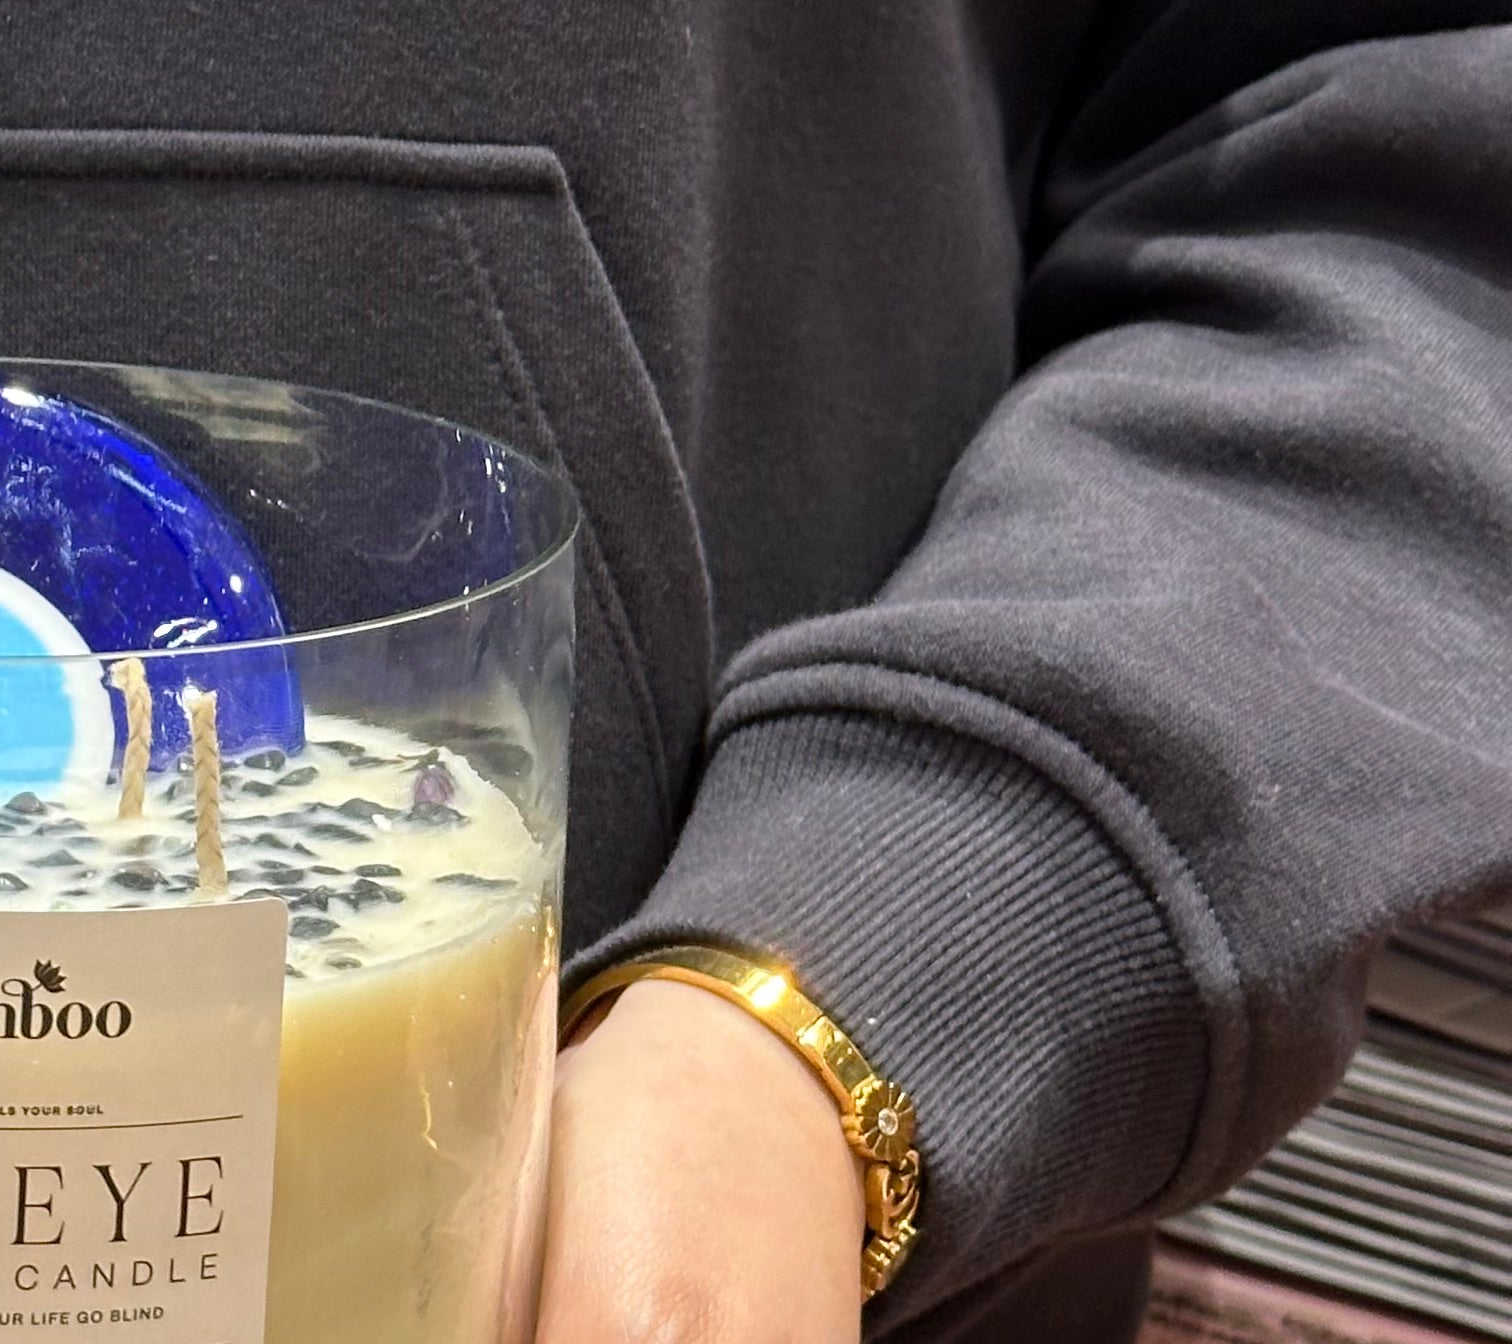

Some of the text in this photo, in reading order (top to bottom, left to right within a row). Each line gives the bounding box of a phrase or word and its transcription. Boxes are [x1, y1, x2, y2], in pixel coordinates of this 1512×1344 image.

[20, 1105, 62, 1118] YOUR
[9, 1155, 225, 1246] EYE
[13, 1252, 219, 1292] CANDLE
[29, 1311, 71, 1327] LIFE
[75, 1309, 105, 1325] GO
[109, 1305, 165, 1323] BLIND
